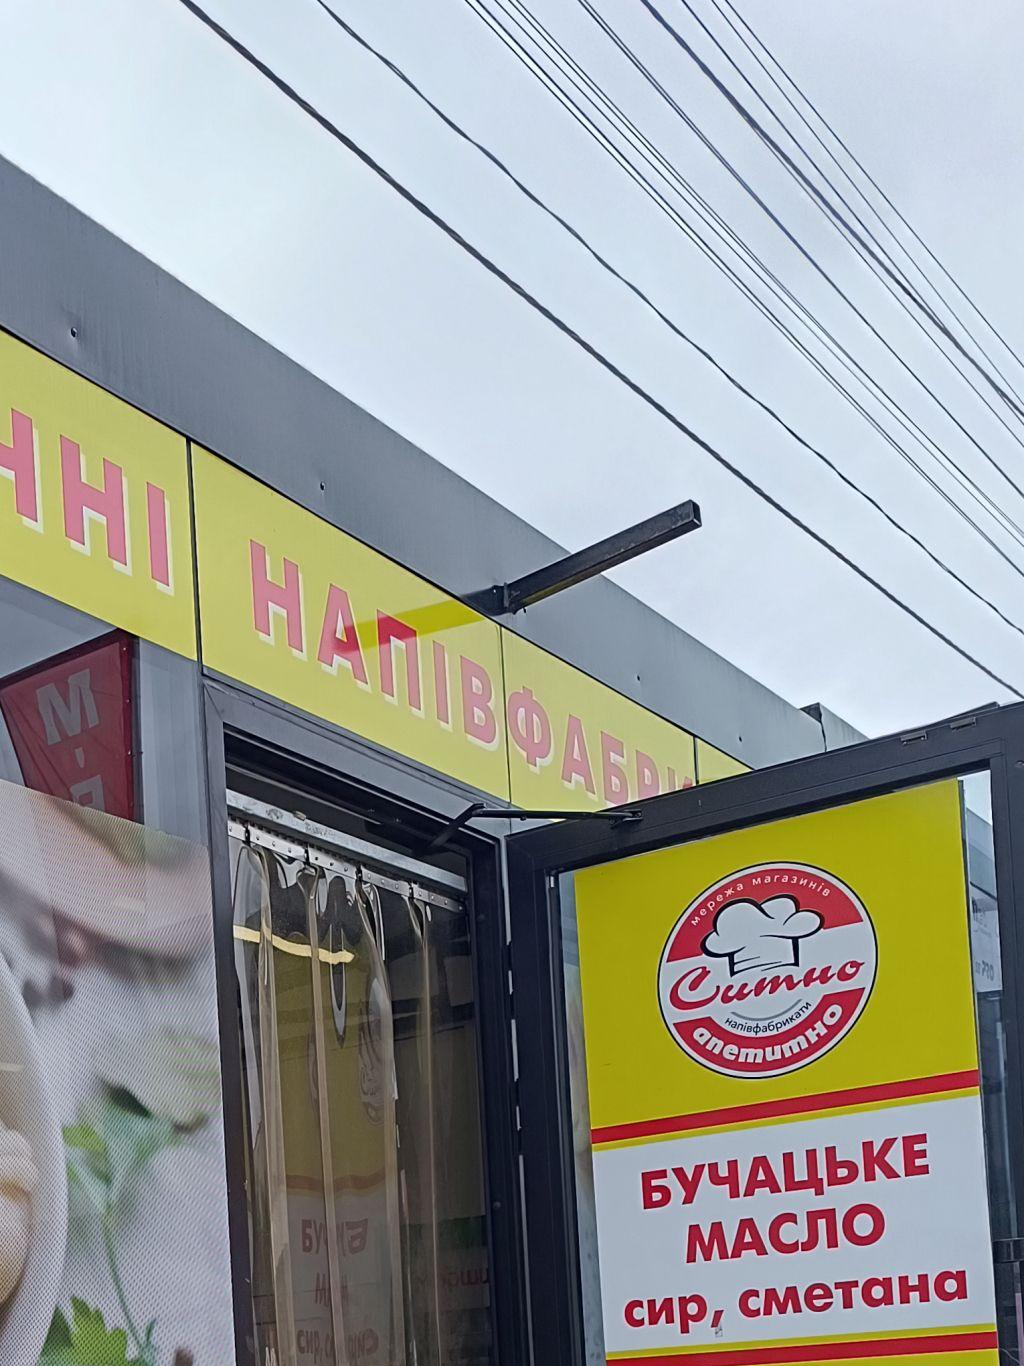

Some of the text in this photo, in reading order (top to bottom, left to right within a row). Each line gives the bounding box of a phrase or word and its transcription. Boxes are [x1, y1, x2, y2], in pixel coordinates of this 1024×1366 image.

[690, 873, 831, 927] мережа магазинів
[669, 959, 865, 1011] Ситно
[692, 1004, 843, 1063] апетитно
[724, 1001, 812, 1035] напівфабрикати
[640, 1132, 930, 1210] БУЧАЦЬКЕ
[685, 1202, 886, 1264] МАСЛО
[624, 1269, 968, 1334] сир, сметана
